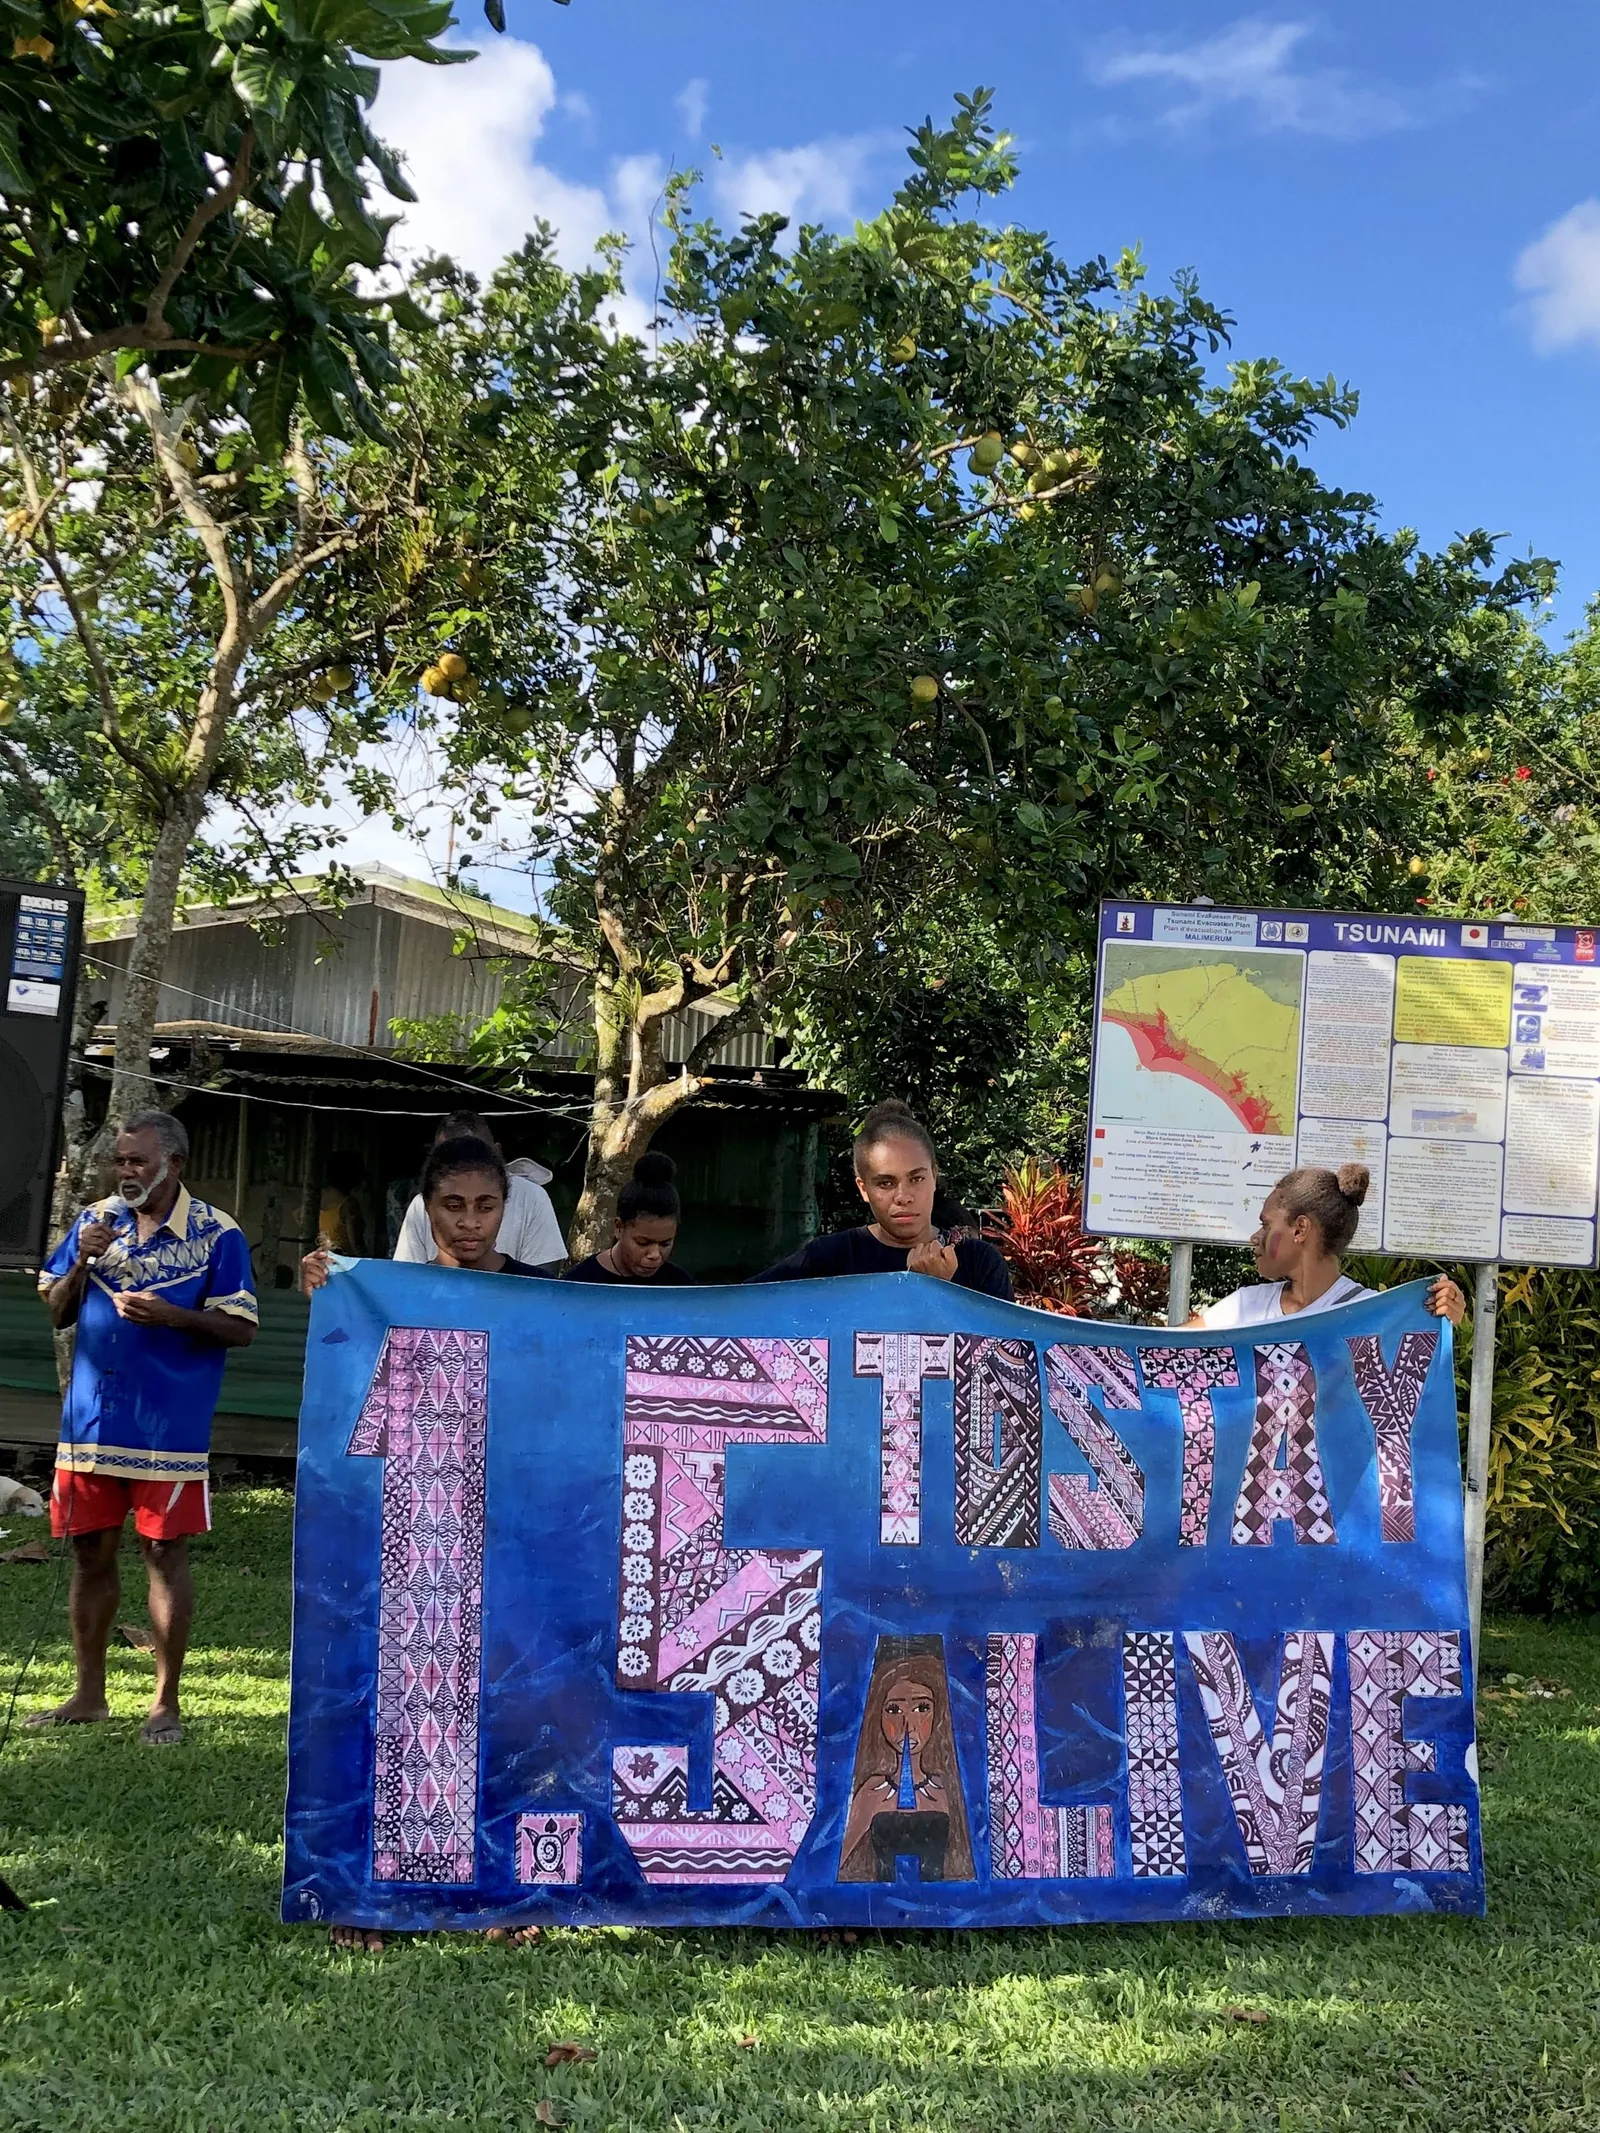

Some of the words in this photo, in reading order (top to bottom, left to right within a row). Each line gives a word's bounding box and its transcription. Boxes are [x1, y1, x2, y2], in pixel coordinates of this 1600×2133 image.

[1185, 933, 1232, 942] MALIMERUM
[1333, 922, 1446, 947] TSUNAMI
[853, 1331, 1041, 1547] TO
[1044, 1331, 1440, 1550] STAY
[346, 1326, 829, 1887] 1.5
[837, 1629, 1470, 1884] ALIVE
